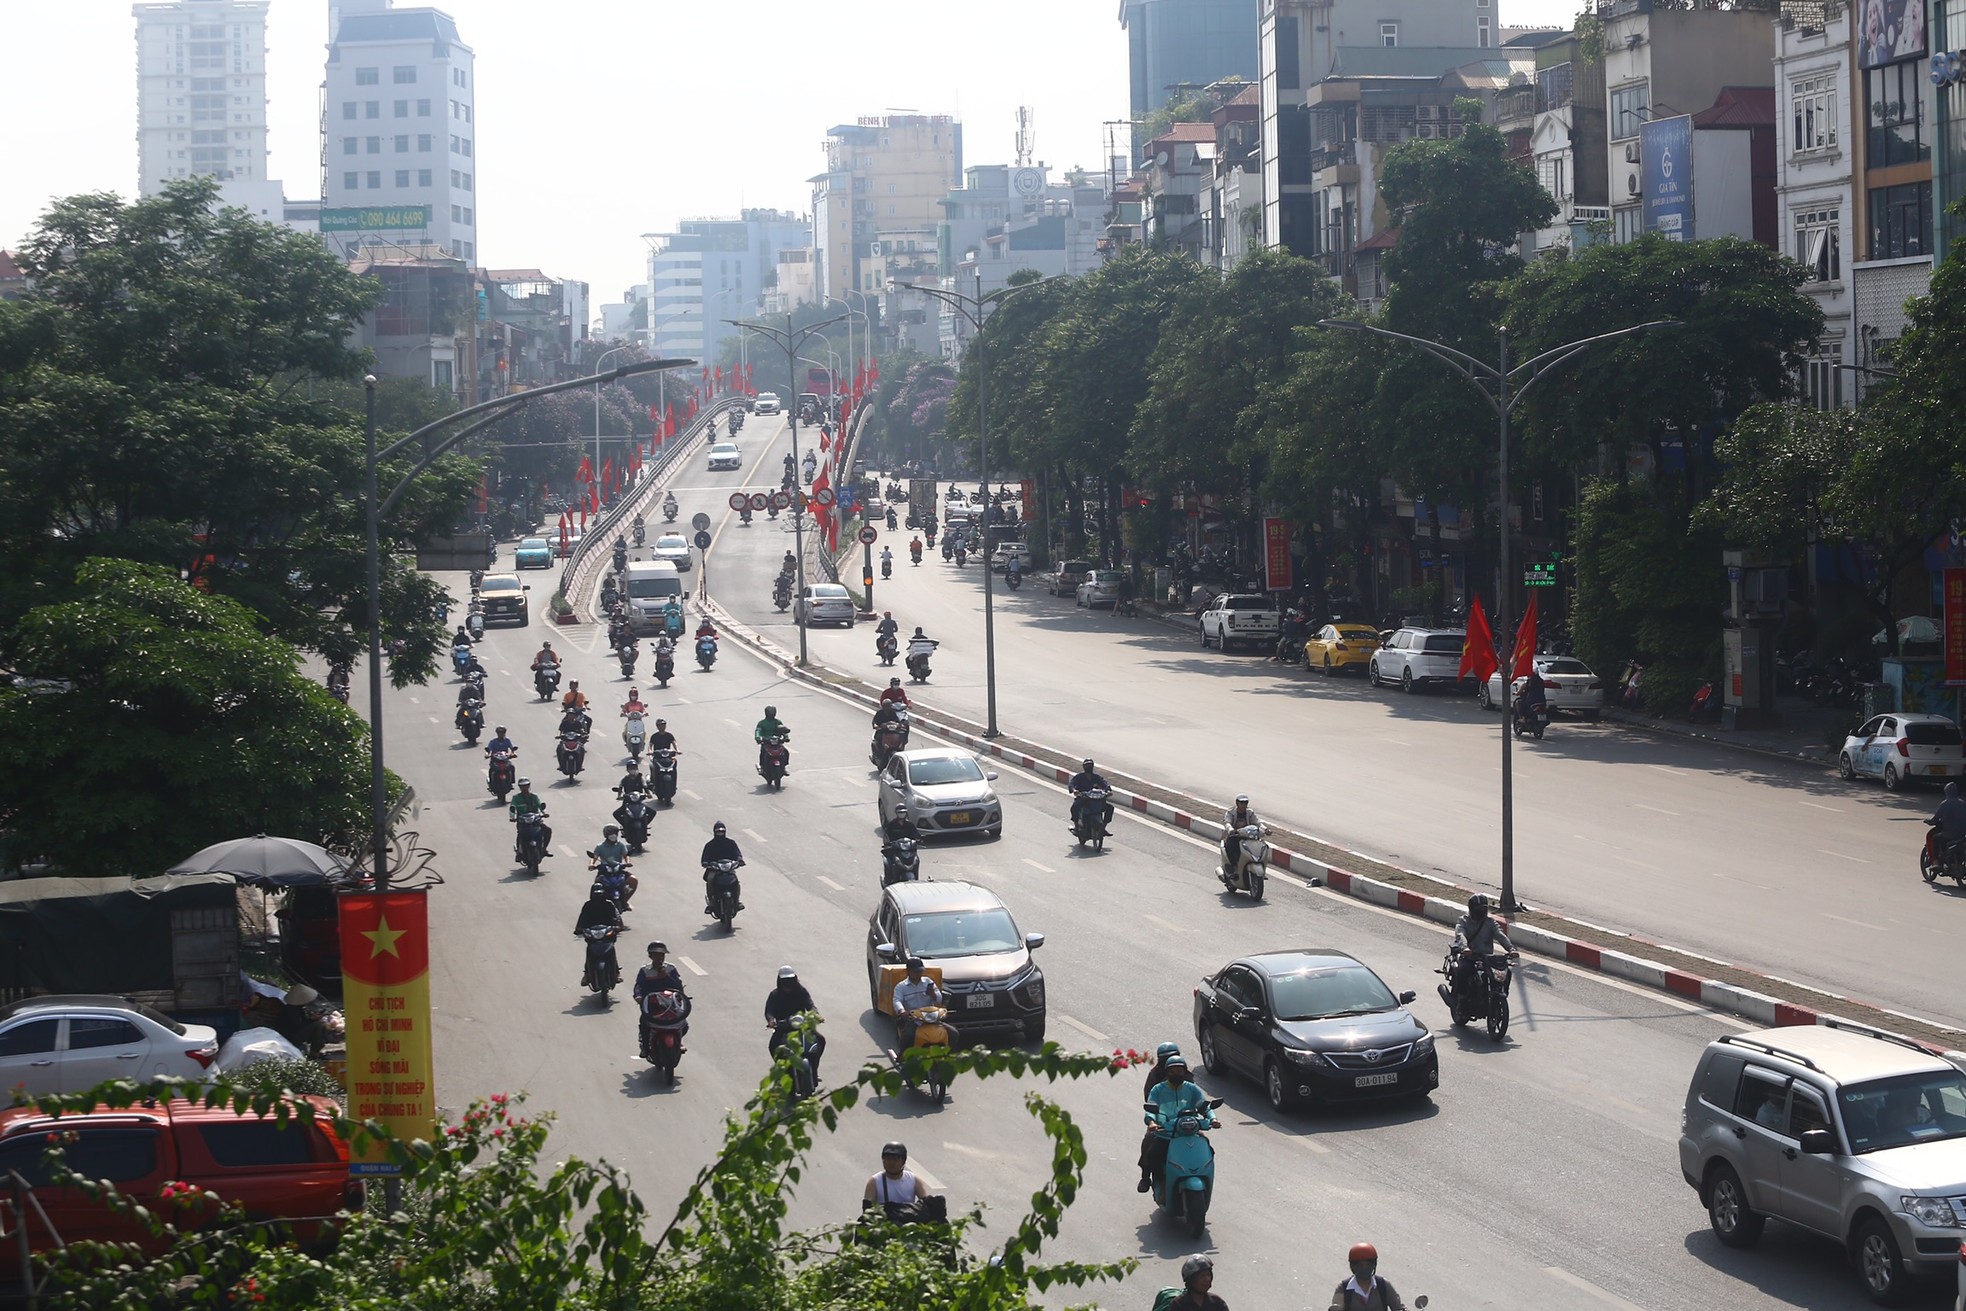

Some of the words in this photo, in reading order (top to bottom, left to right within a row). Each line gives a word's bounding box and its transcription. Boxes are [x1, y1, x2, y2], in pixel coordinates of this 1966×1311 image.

[368, 212, 384, 226] 090
[385, 211, 400, 226] 464
[402, 211, 424, 225] 6699
[369, 992, 385, 1010] CHỦ
[386, 997, 405, 1013] TỊCH
[375, 1016, 389, 1032] CHÍ
[391, 1018, 413, 1032] MINH
[385, 1039, 400, 1056] ĐẠI
[369, 1057, 391, 1074] SỐNG
[393, 1058, 409, 1074] MÃI
[354, 1082, 382, 1096] TRONG
[383, 1081, 394, 1099] SỰ
[395, 1079, 425, 1098] NGHIỆP
[359, 1098, 377, 1117] CỦA
[378, 1101, 405, 1117] CHÚNG
[406, 1103, 417, 1117] TA
